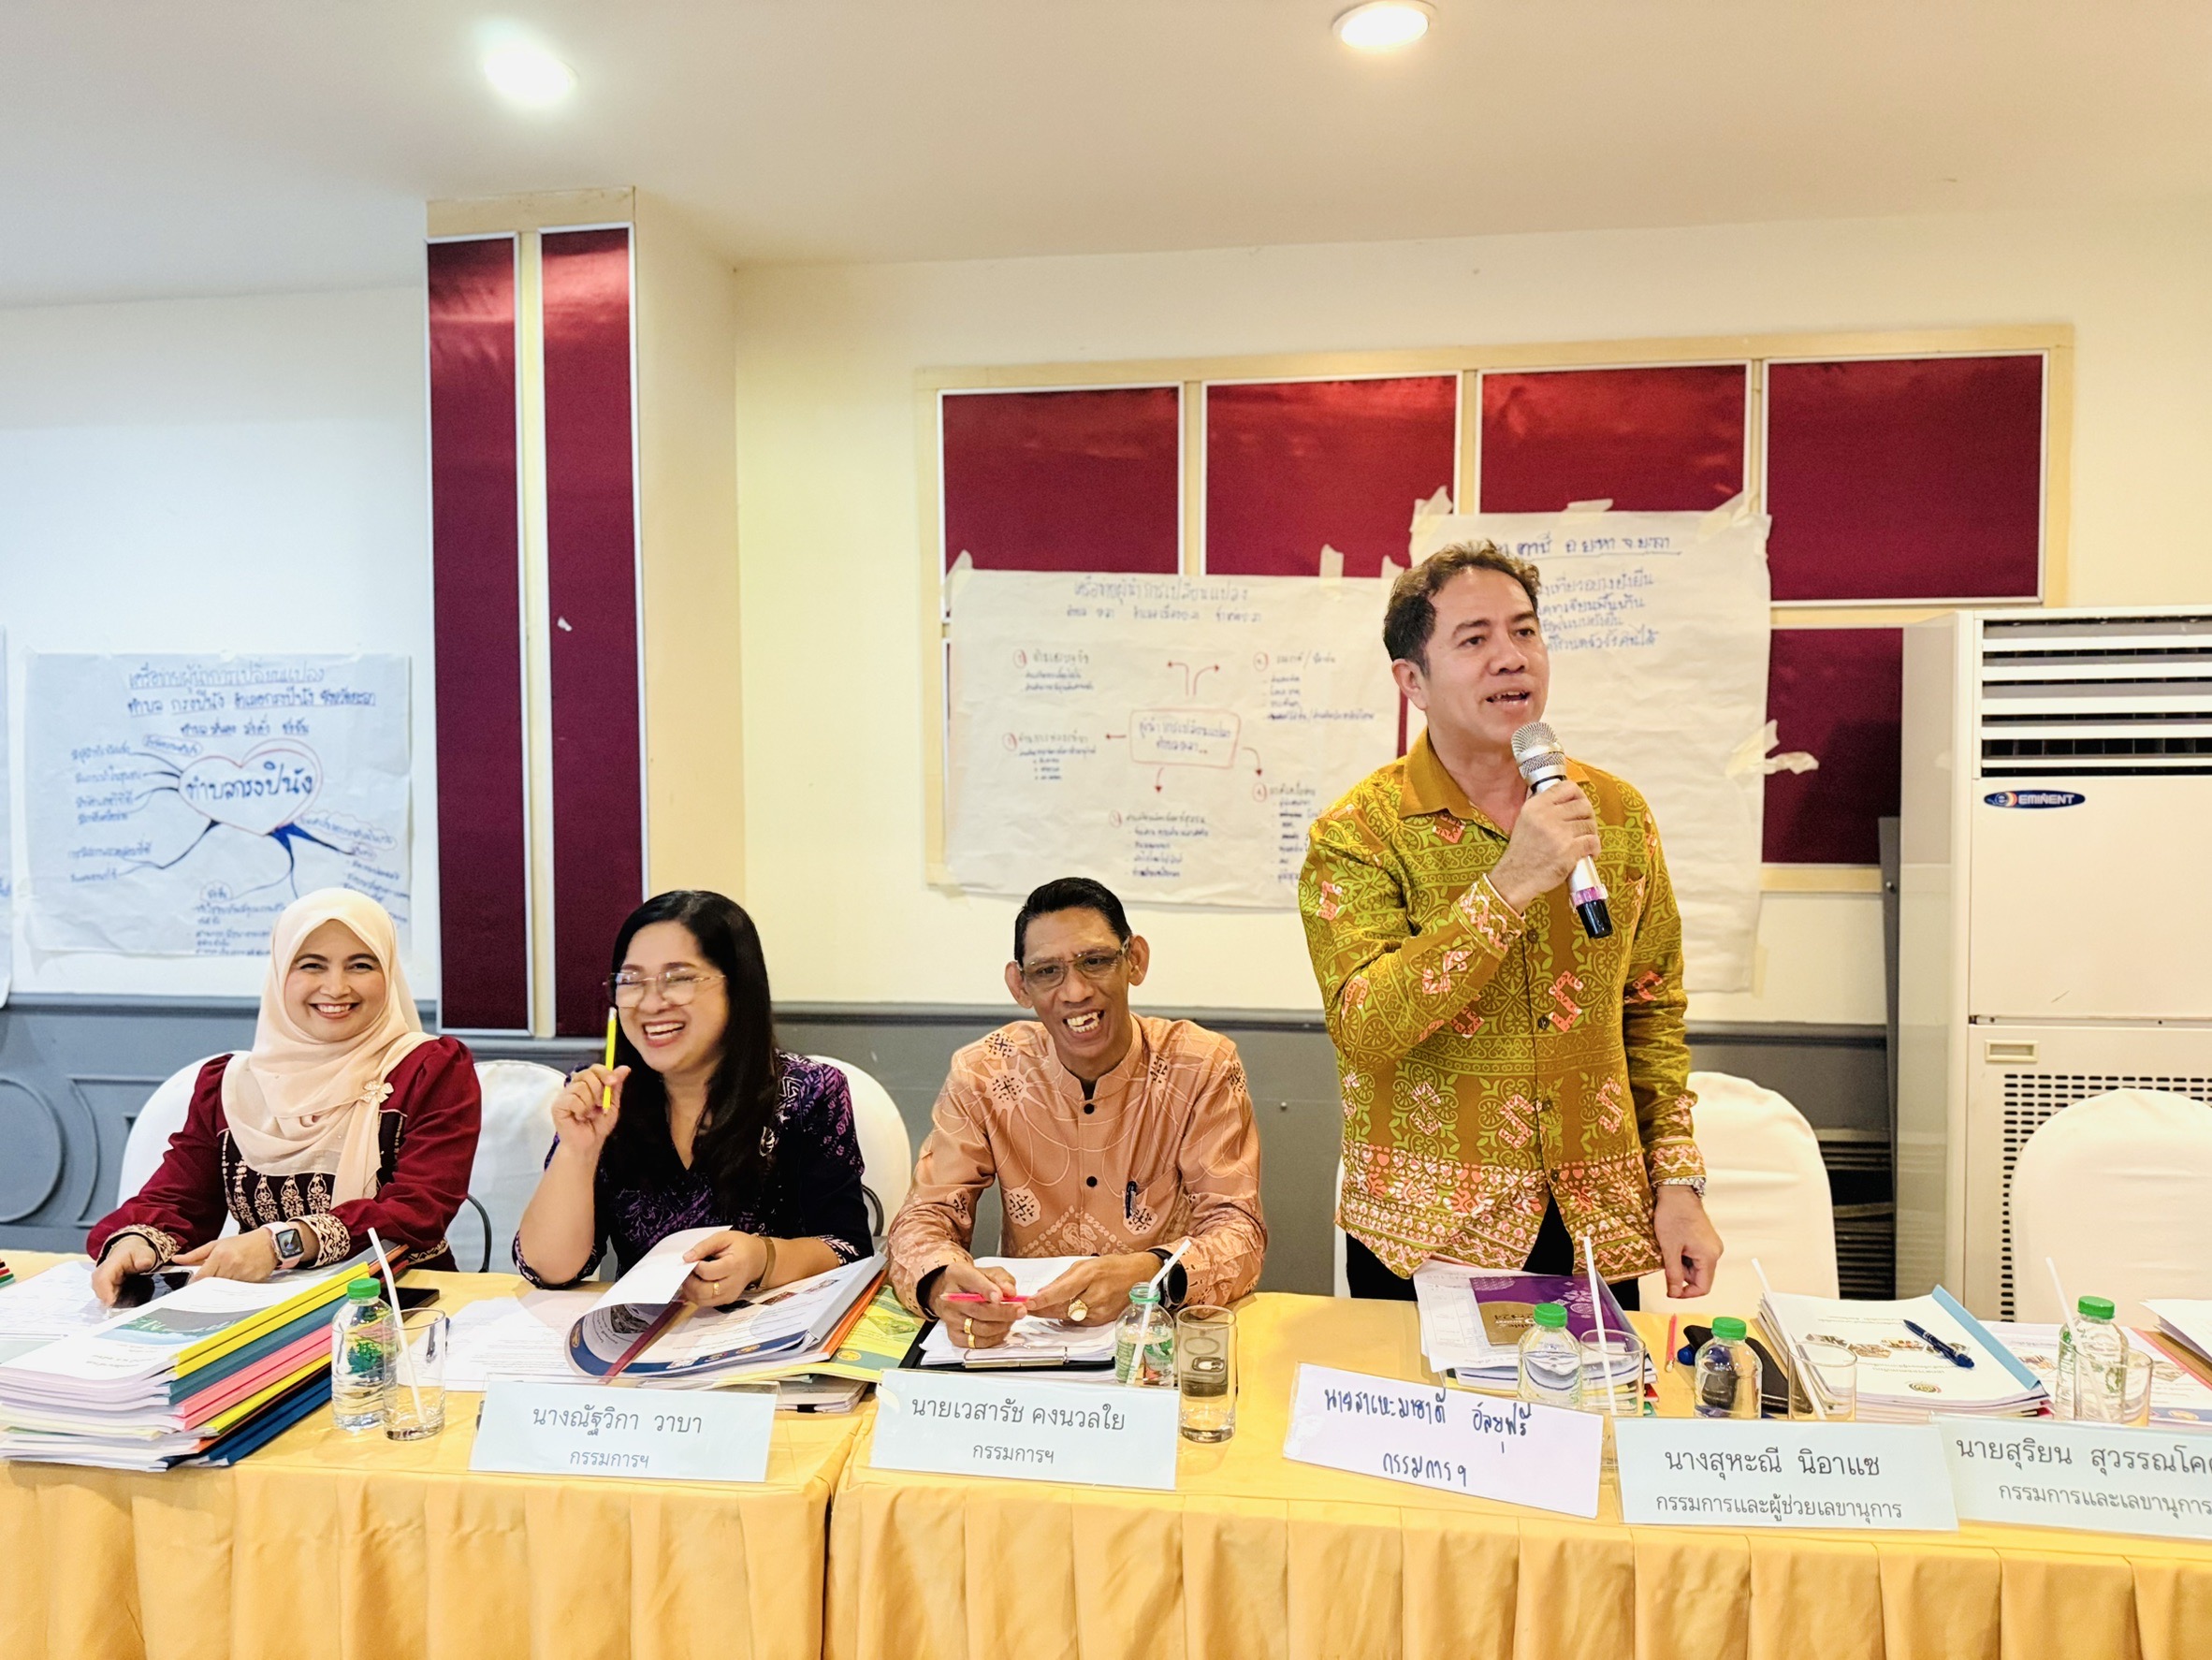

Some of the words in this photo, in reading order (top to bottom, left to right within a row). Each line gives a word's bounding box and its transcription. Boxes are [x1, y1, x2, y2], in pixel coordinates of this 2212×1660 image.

[532, 1404, 639, 1436] นางณัฐวิกา
[654, 1415, 703, 1434] วาบา
[911, 1398, 1025, 1423] นายเวสารัช
[1032, 1404, 1126, 1431] คงนวลใย
[570, 1450, 649, 1469] กรรมการฯ
[972, 1444, 1055, 1464] กรรมการฯ
[1665, 1447, 1783, 1479] นางสุหะณี
[1797, 1449, 1881, 1477] นิอาแซ
[1956, 1437, 2073, 1470] นายสุริยน
[1656, 1493, 1902, 1523] กรรมการและผู้ช่วยเลขานุการ
